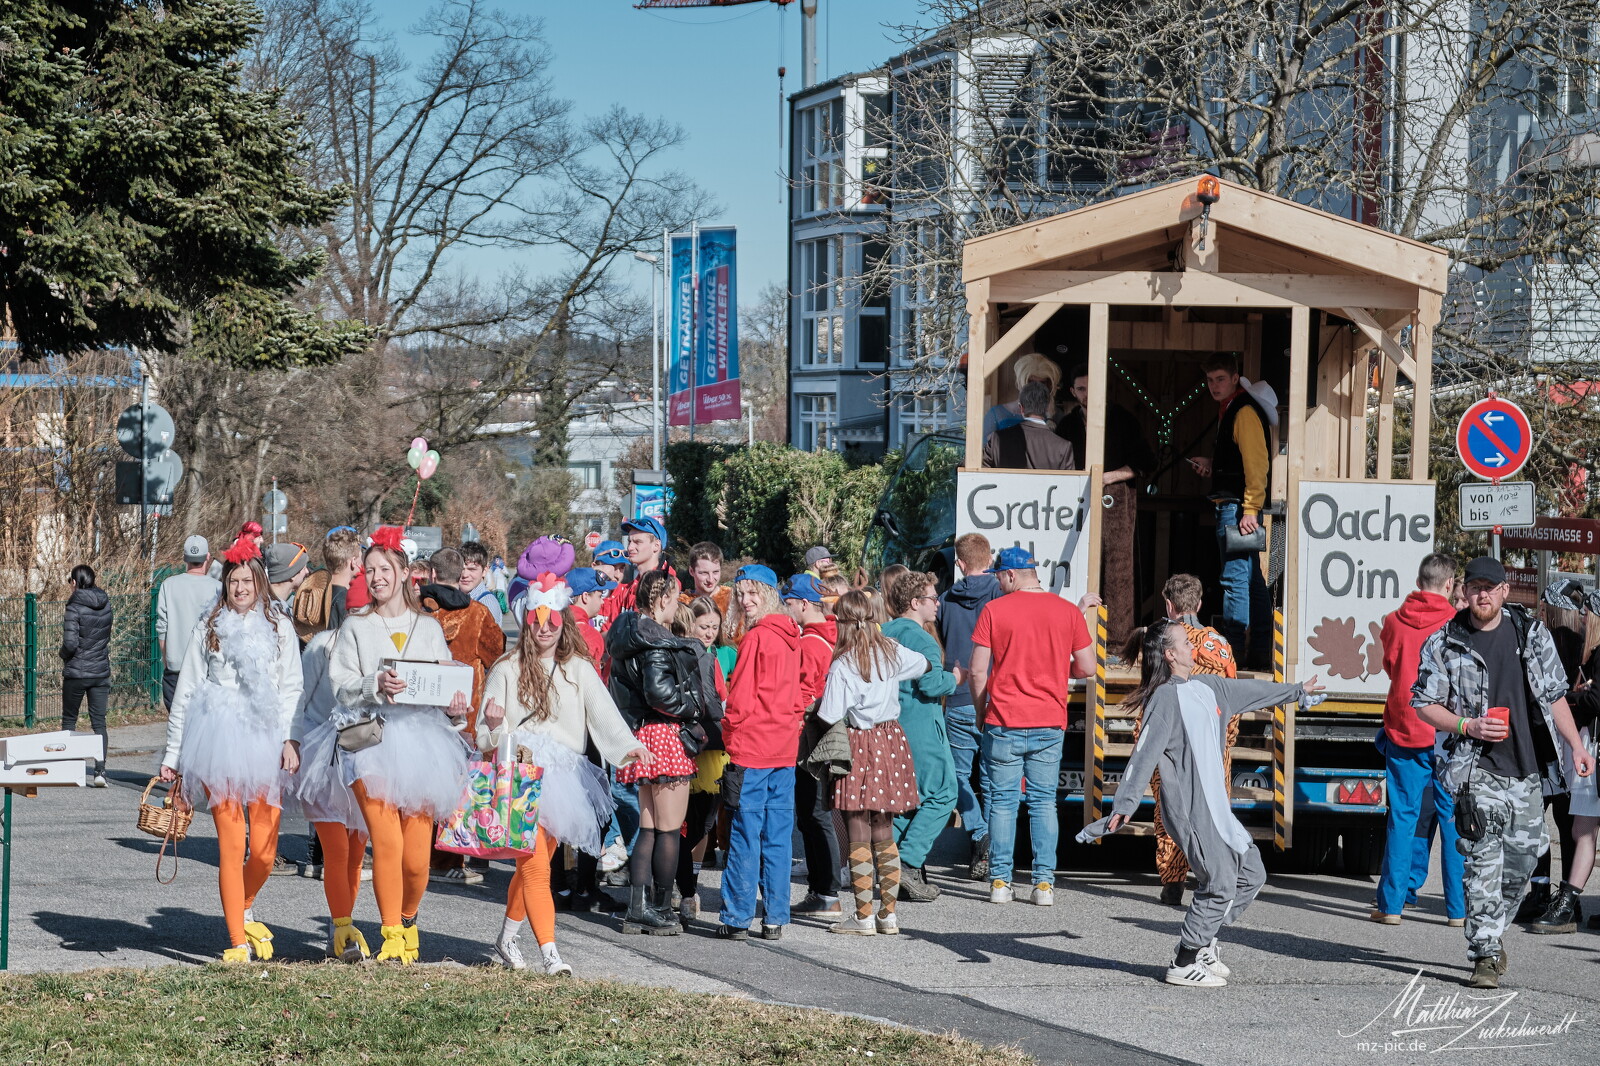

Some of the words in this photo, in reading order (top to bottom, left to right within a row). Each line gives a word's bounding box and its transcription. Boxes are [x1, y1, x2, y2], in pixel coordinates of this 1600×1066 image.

[679, 281, 692, 384] GETRÄNKE
[706, 273, 717, 379] GETRÄNKE
[718, 283, 729, 369] WINKLER
[966, 483, 1085, 533] Grafei
[1301, 492, 1431, 543] Oache
[1469, 493, 1494, 504] von
[1469, 508, 1489, 521] bis
[1503, 528, 1582, 543] KOHLHAASSTRASSE
[1586, 530, 1594, 544] 9
[1320, 550, 1400, 599] Oim
